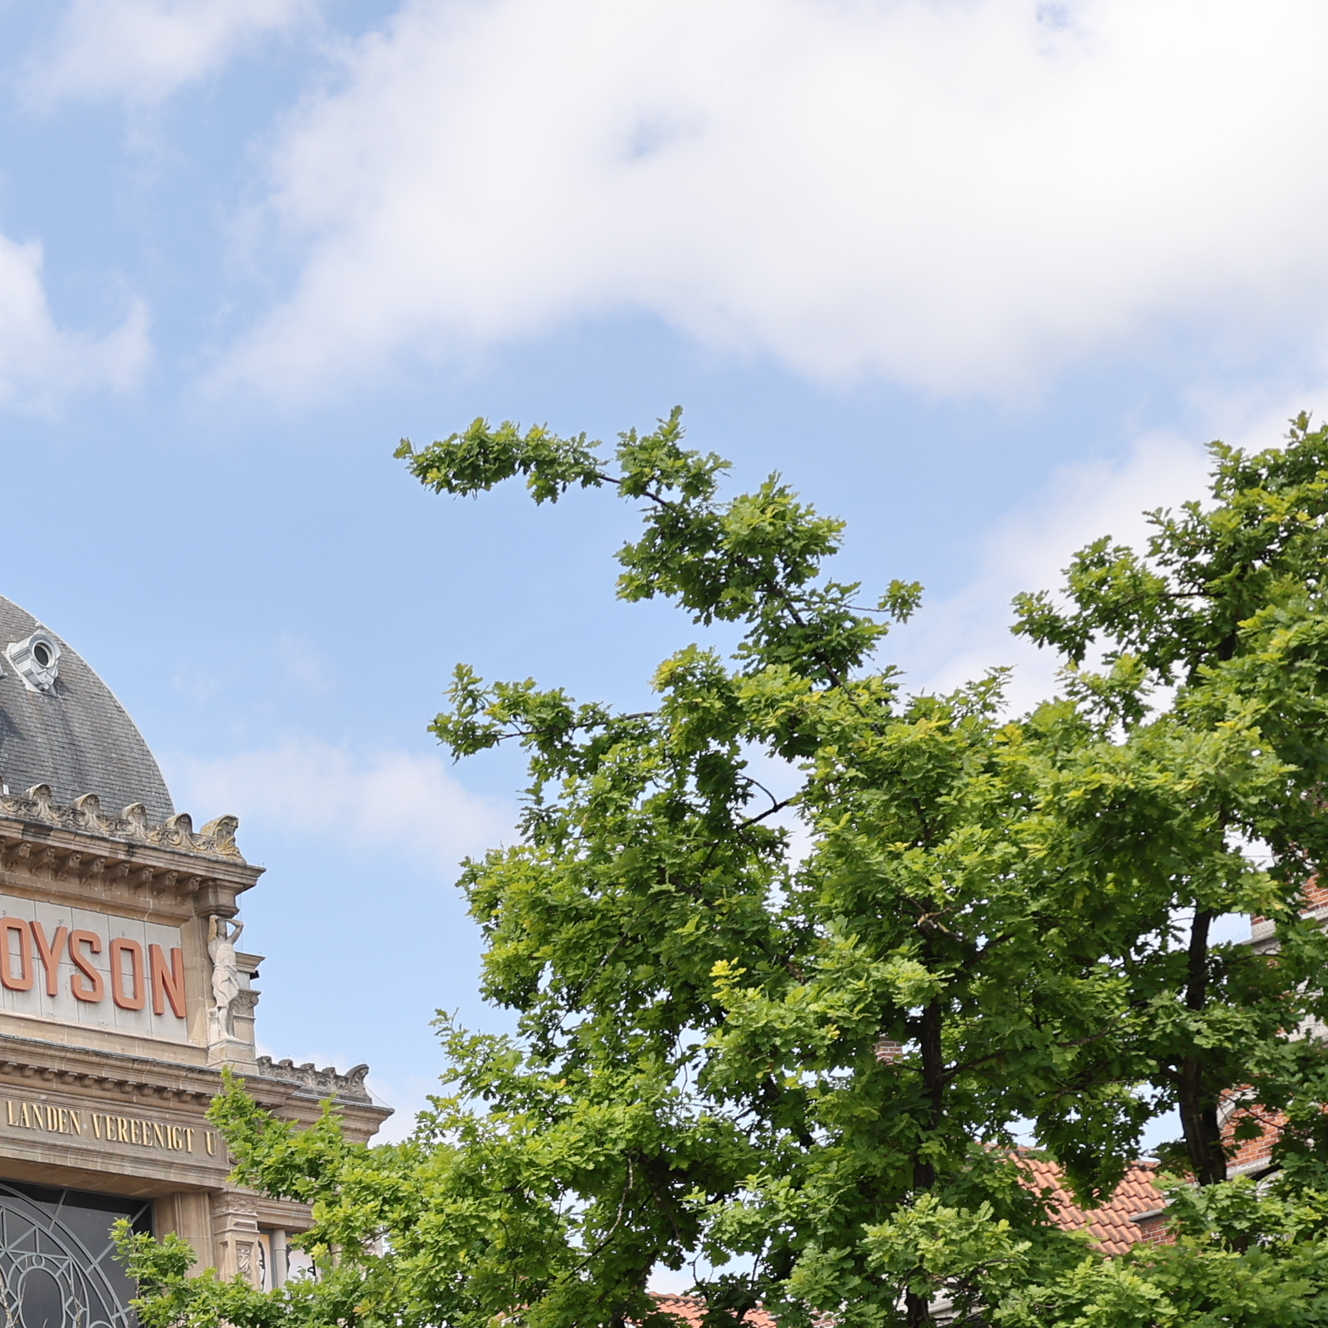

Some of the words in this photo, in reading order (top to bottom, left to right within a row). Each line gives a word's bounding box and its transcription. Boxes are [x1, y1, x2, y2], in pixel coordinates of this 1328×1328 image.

[7, 1100, 81, 1135] LANDEN
[92, 1113, 194, 1153] VEREENIGT
[204, 1130, 217, 1155] U
